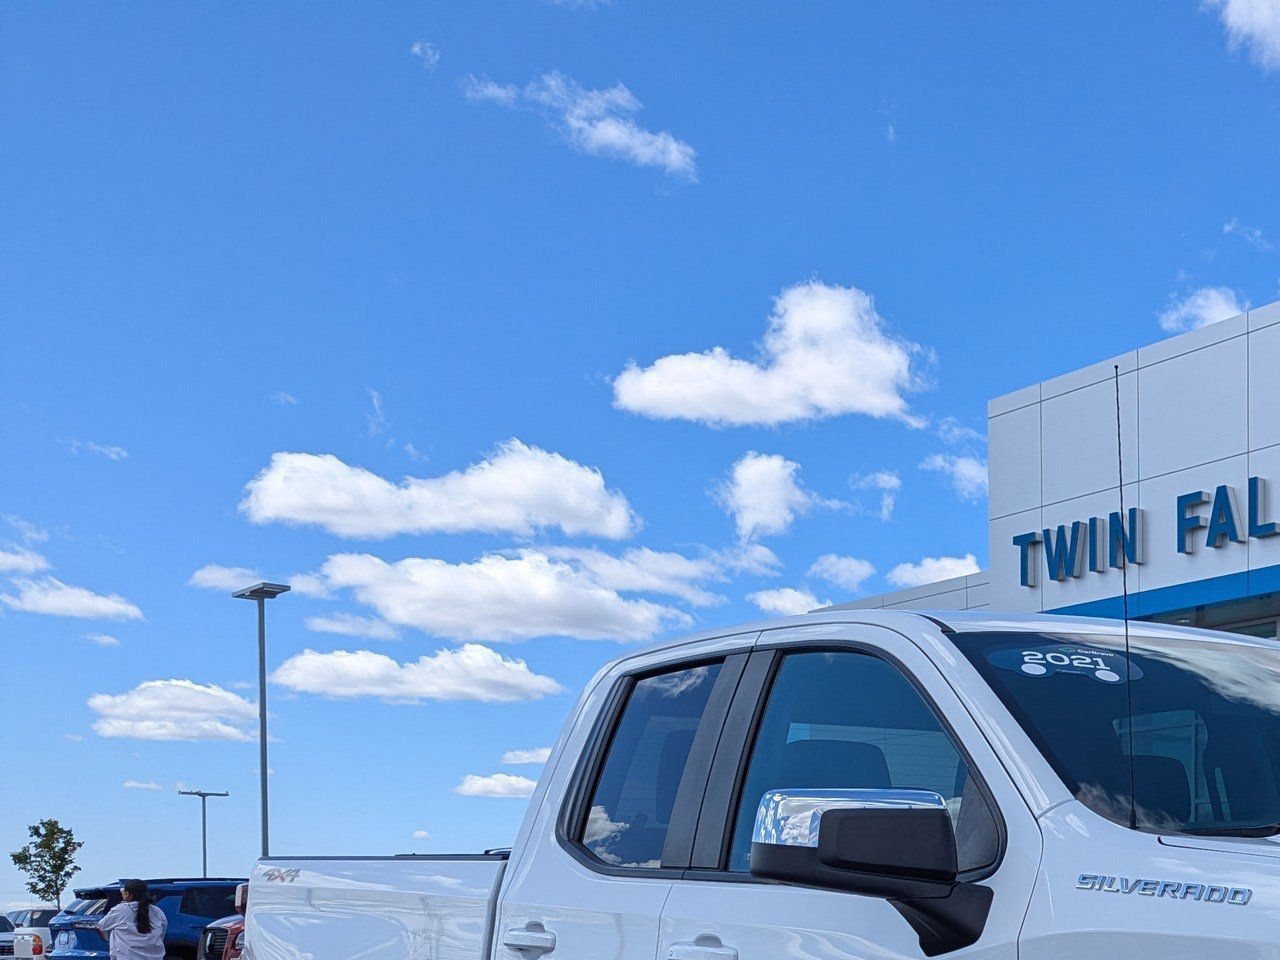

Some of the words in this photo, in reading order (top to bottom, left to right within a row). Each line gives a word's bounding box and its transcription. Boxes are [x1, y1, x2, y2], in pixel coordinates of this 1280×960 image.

[1012, 506, 1144, 587] TWIN
[1021, 650, 1111, 671] 2021
[1075, 873, 1253, 906] SILVERADO
